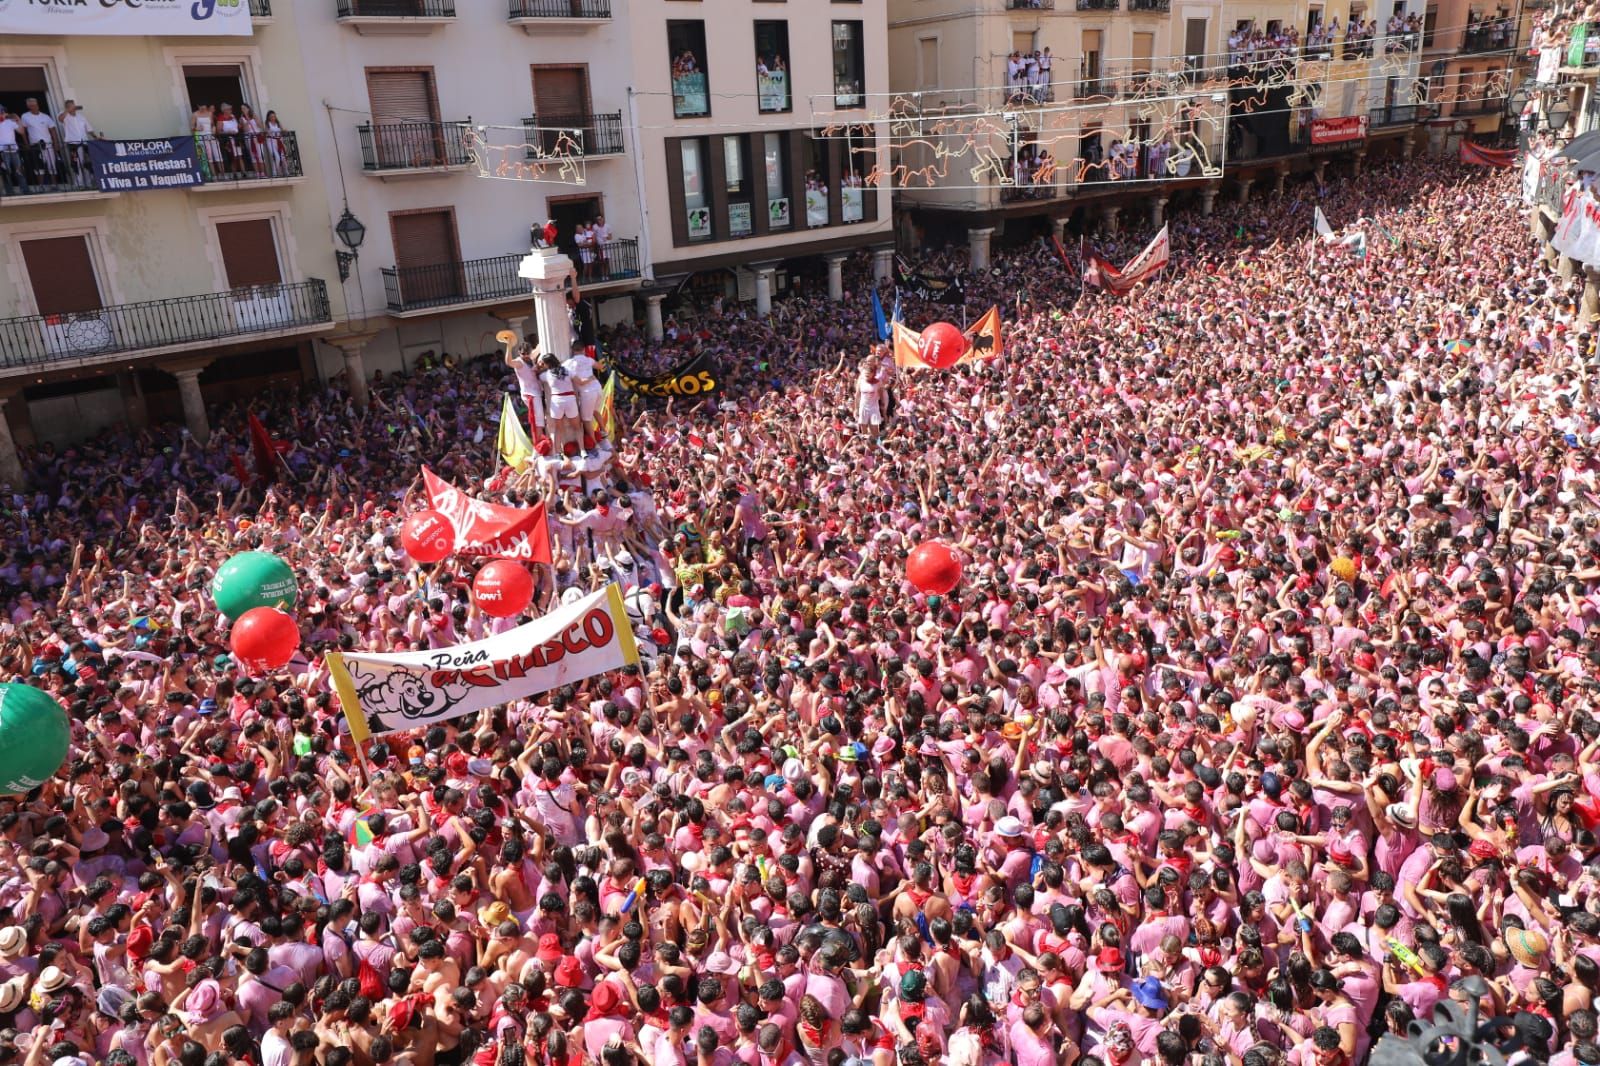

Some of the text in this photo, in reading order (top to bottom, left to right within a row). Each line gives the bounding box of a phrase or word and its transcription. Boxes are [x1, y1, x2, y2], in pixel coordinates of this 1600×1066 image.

[107, 177, 132, 189] Viva
[135, 176, 148, 187] La
[150, 173, 194, 186] Vaquilla
[475, 589, 503, 601] Lowi
[431, 649, 490, 670] Peña
